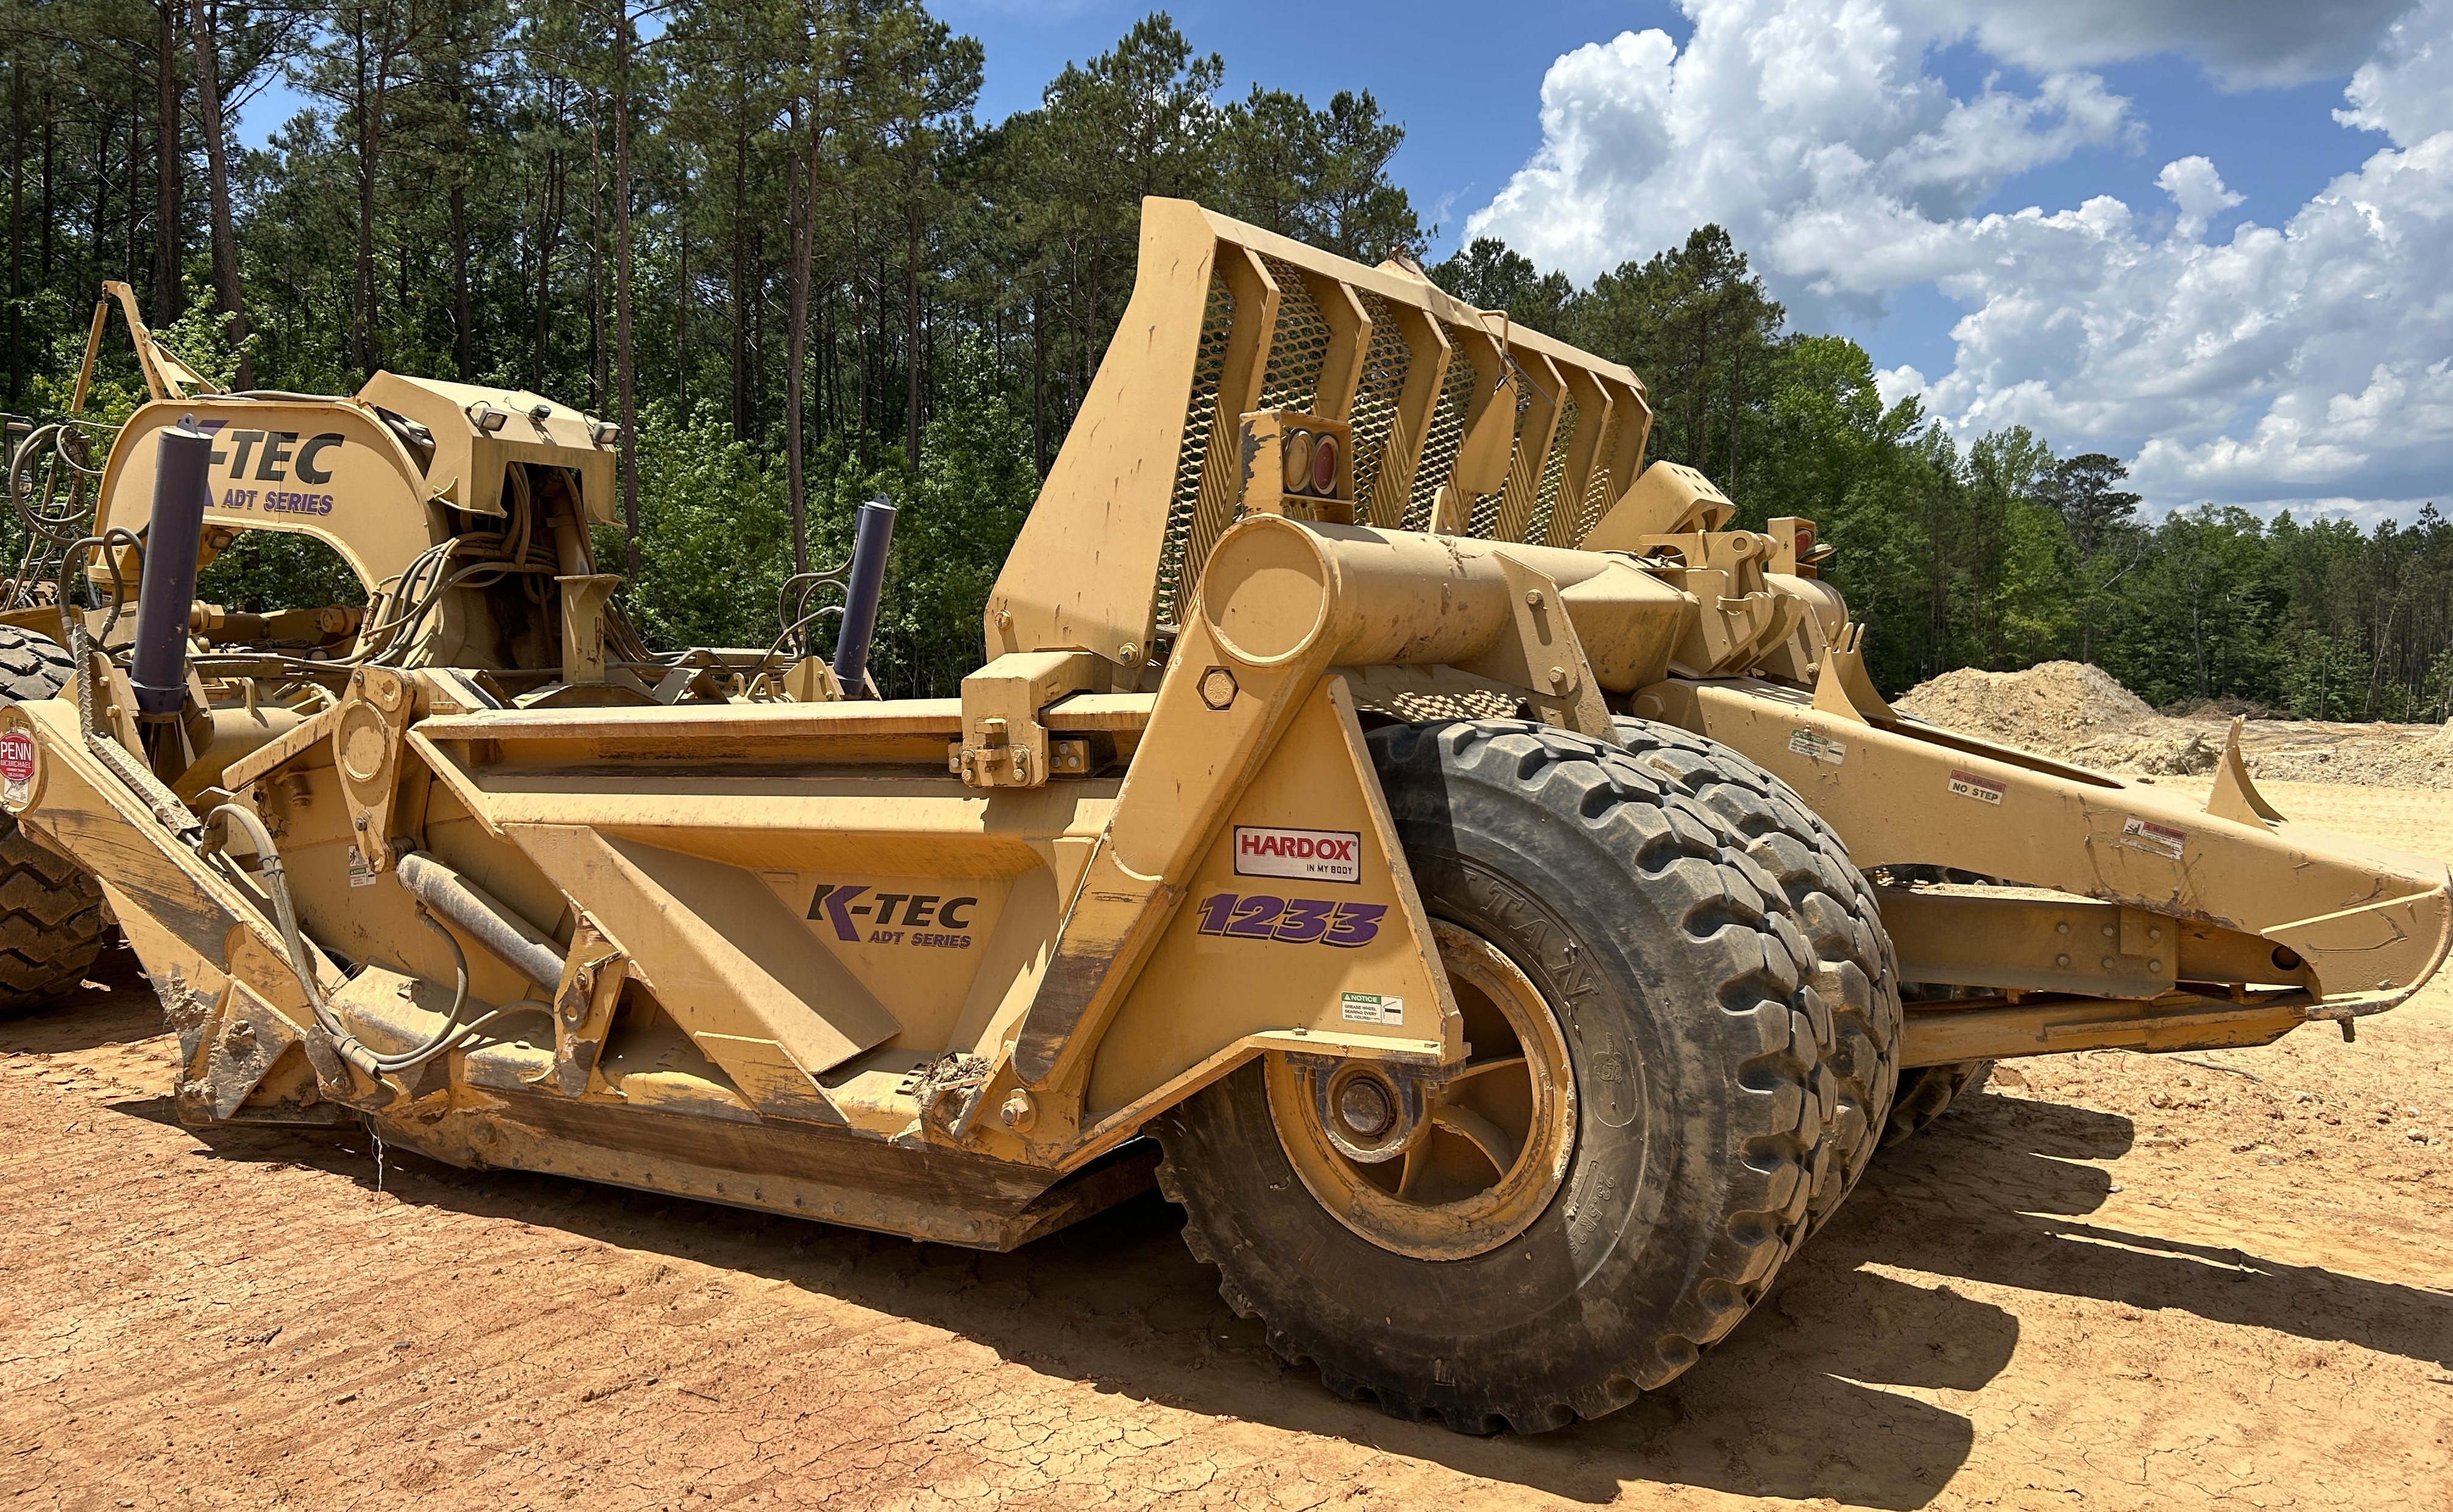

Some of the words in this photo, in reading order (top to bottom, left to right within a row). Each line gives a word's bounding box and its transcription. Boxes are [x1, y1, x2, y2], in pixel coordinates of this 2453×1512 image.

[221, 489, 258, 509] ADT
[264, 491, 334, 515] SERIES
[1, 741, 32, 761] PENN
[1952, 782, 1968, 793] NO
[1972, 788, 1998, 801] STEP
[1241, 834, 1352, 861] HARDOX
[1317, 864, 1328, 873] MY
[1331, 865, 1353, 875] BODY
[806, 884, 978, 942] K-TEC
[1196, 893, 1389, 949] 1233
[868, 930, 905, 945] ADT
[911, 933, 972, 949] SERIES
[1351, 994, 1378, 1003] NOTICE
